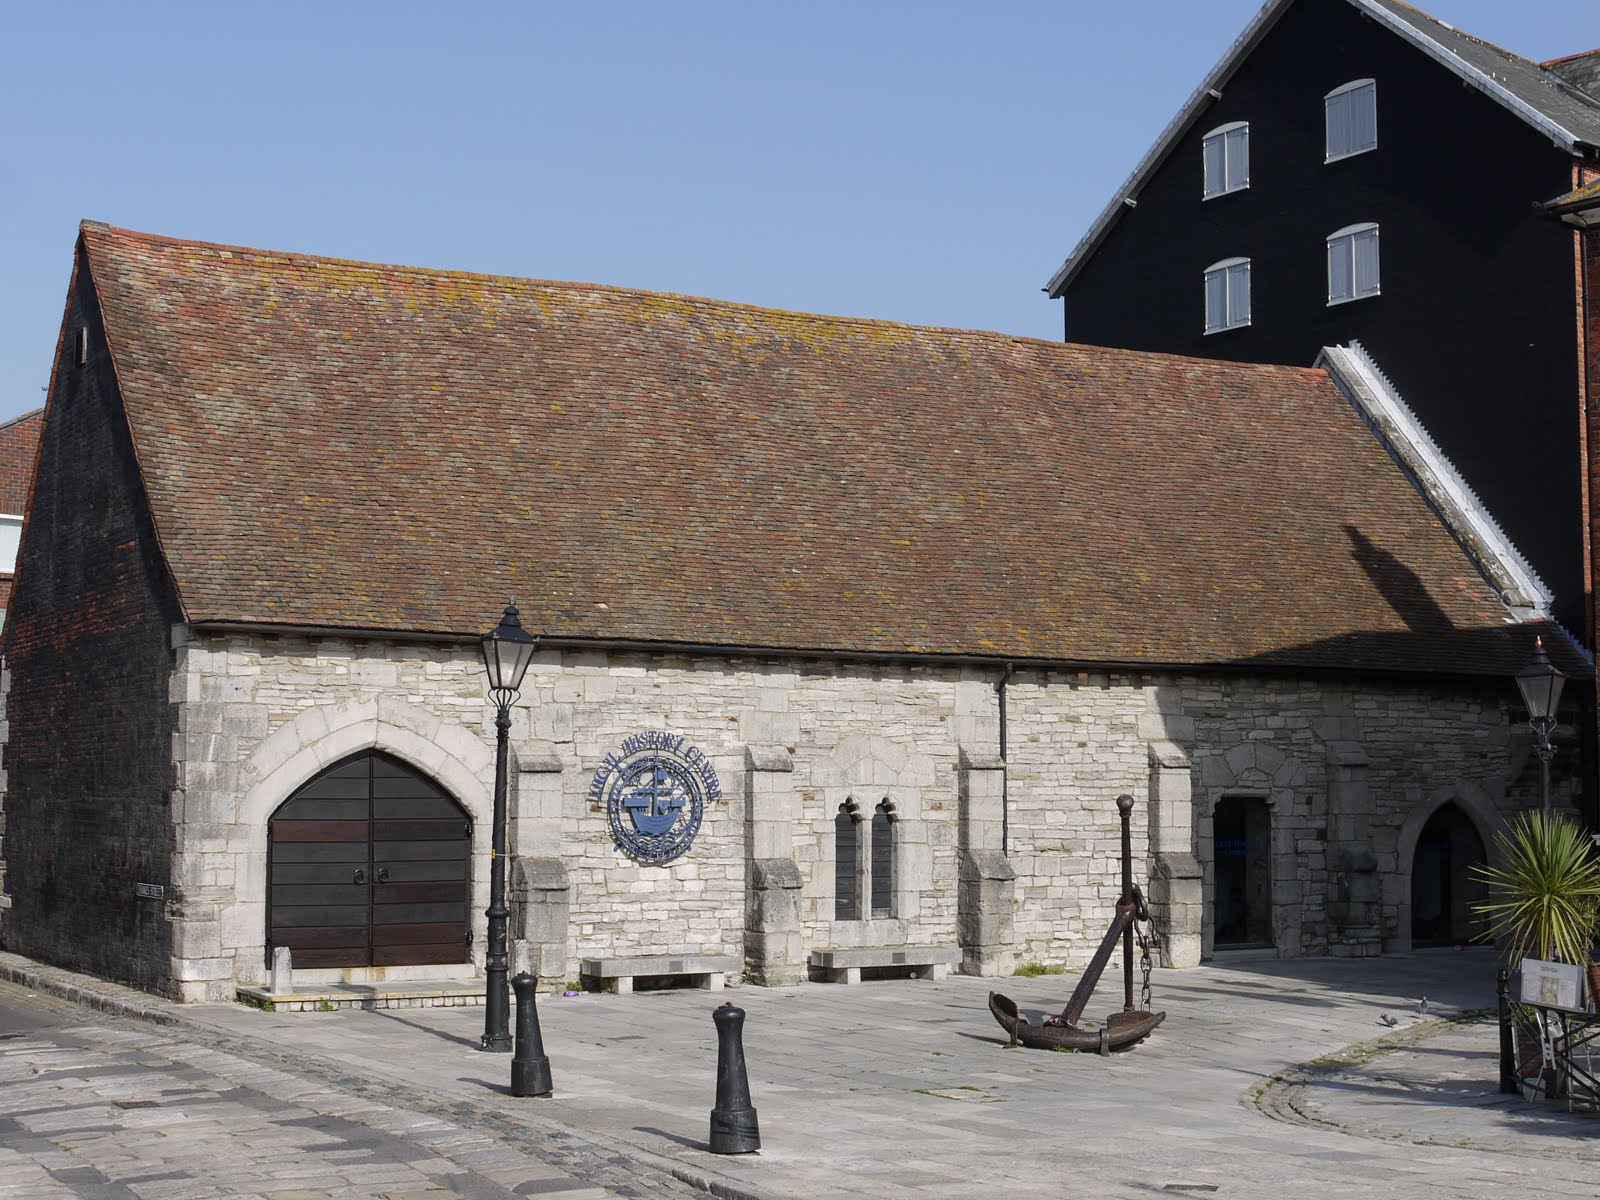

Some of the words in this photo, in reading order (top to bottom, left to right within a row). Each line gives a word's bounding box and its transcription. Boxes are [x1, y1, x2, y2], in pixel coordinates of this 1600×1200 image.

[588, 752, 620, 801] LOCAL
[622, 731, 685, 755] HISTORY
[686, 746, 722, 802] CENTRE
